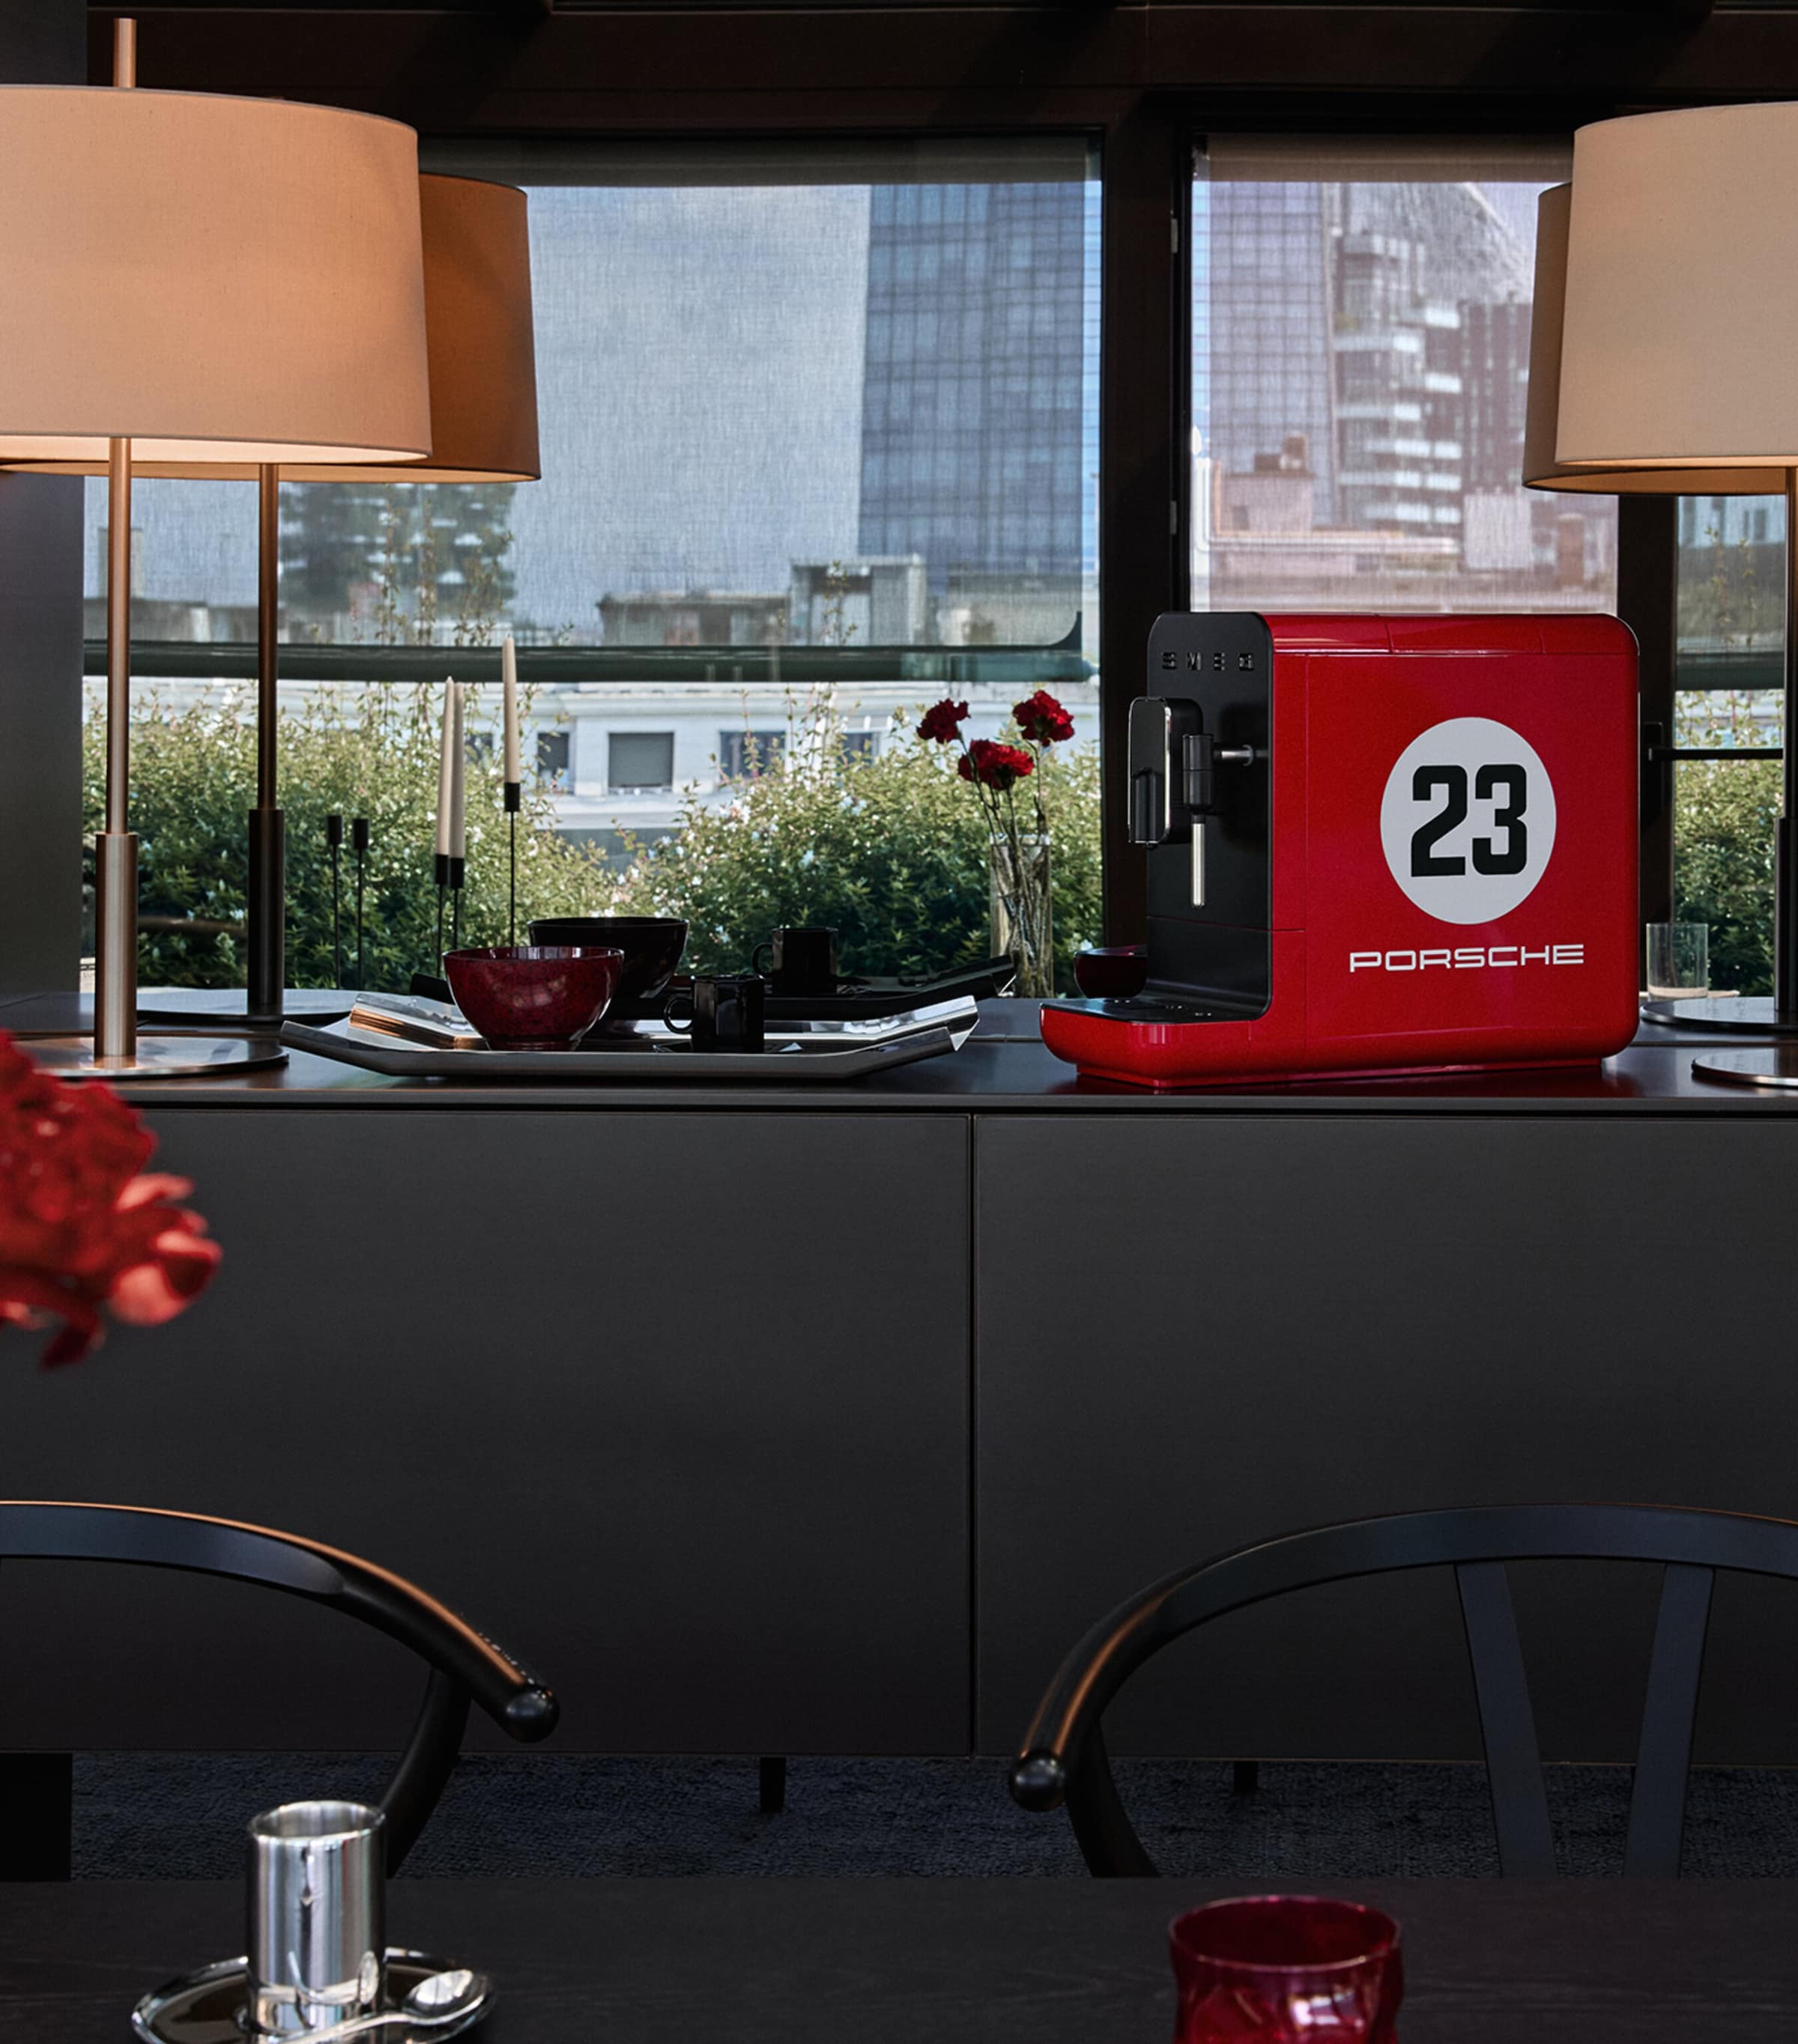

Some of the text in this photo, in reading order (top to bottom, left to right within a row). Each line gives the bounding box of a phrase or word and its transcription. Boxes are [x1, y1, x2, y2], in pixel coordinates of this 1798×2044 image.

[1161, 652, 1254, 670] SMEG
[1411, 764, 1528, 877] 23
[1349, 944, 1584, 973] PORSCHE
